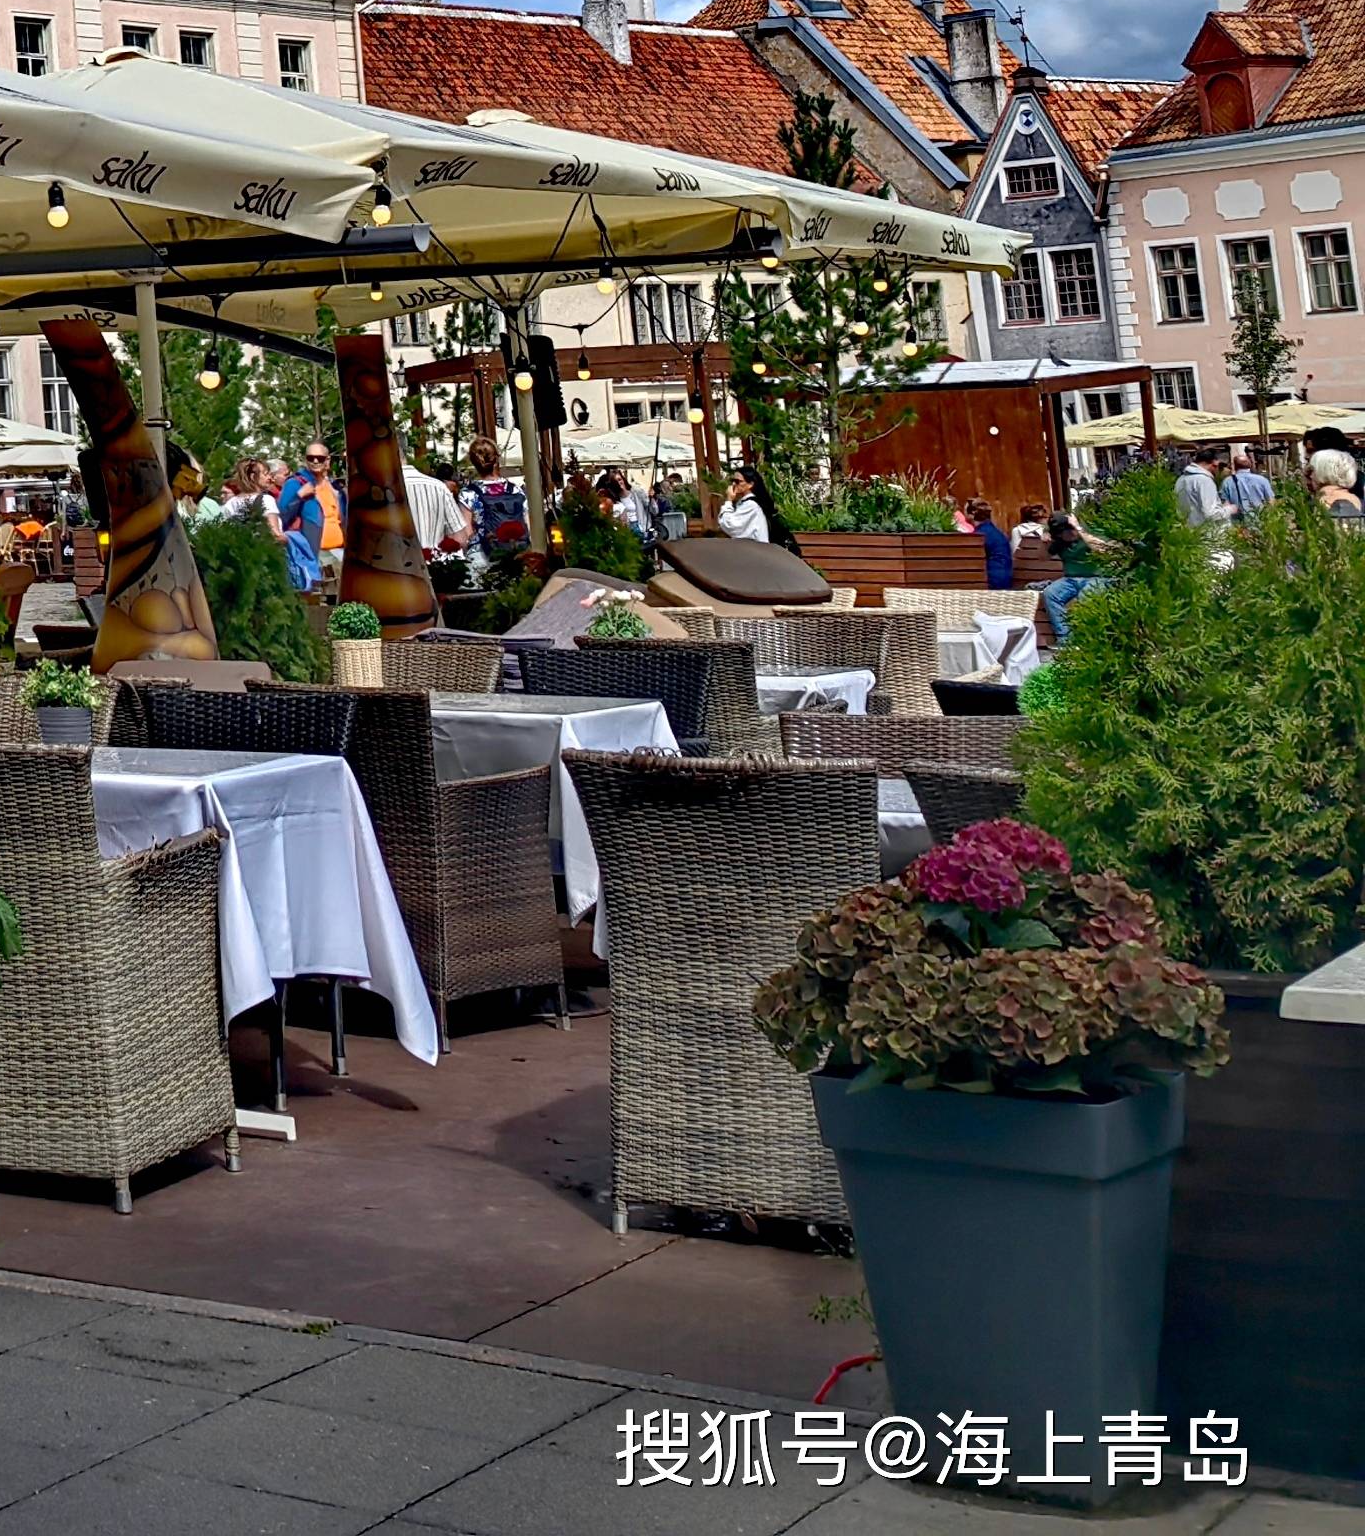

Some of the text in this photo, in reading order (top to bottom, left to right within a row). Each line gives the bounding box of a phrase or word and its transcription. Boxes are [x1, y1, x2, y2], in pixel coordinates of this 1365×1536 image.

[92, 149, 167, 195] saku
[414, 154, 478, 187] saku
[539, 154, 600, 187] saku
[233, 176, 297, 221] saku
[800, 211, 831, 243] saku
[867, 214, 907, 246] saku
[941, 224, 971, 256] saku
